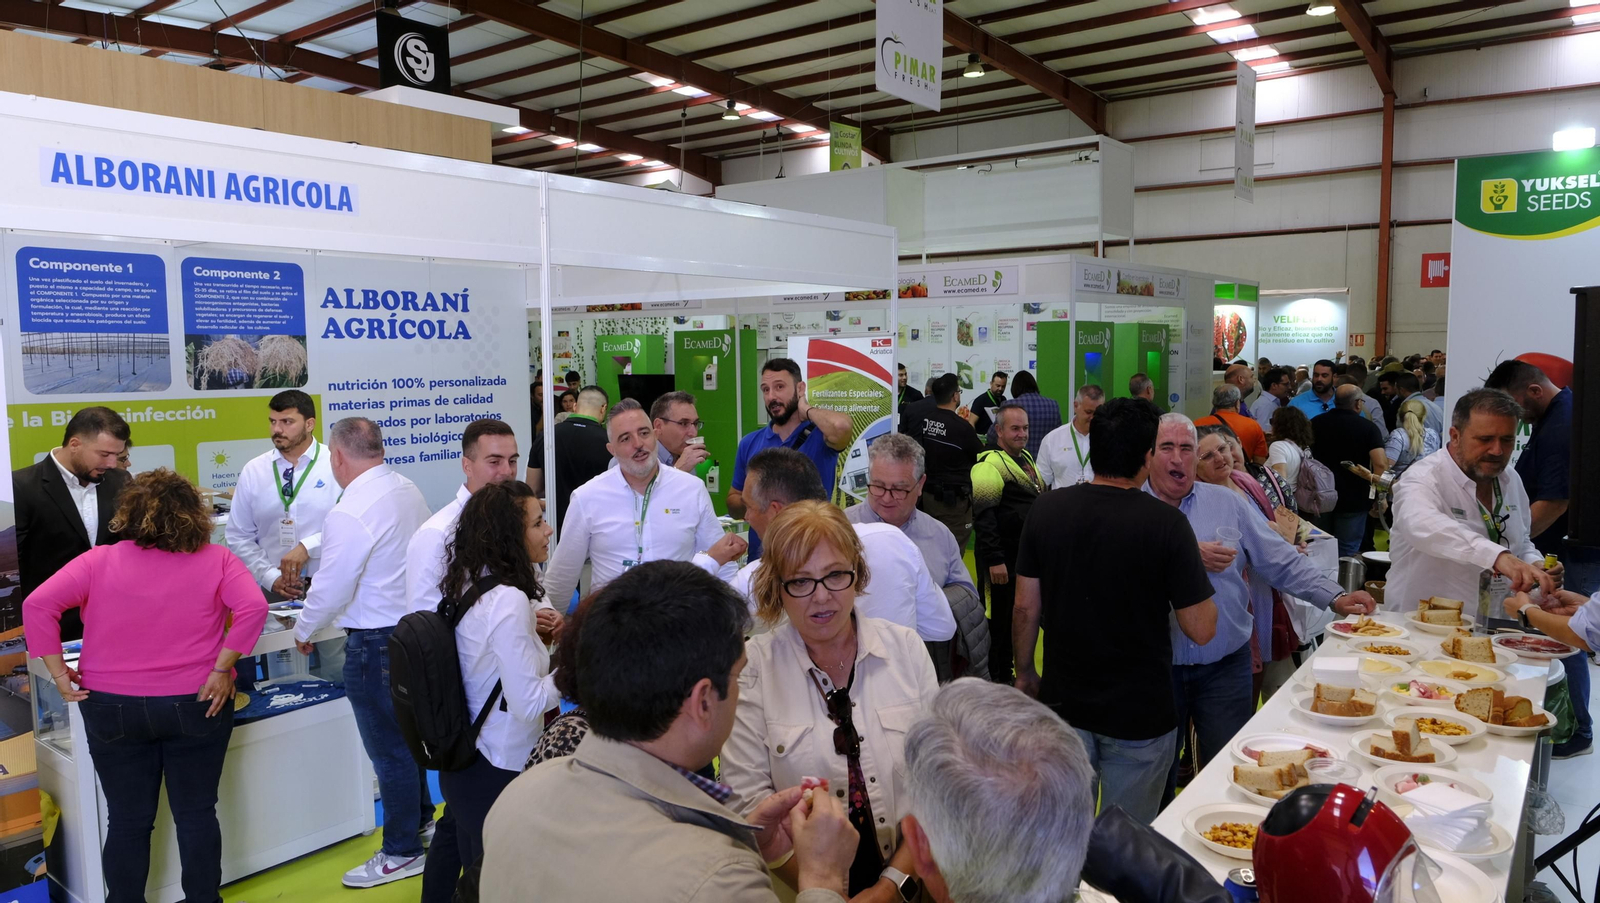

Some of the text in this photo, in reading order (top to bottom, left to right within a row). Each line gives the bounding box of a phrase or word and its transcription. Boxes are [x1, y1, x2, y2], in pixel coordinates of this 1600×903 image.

[894, 51, 935, 83] PIMAR
[894, 72, 928, 90] FRESH
[51, 152, 353, 212] ALBORANI AGRICOLA
[1521, 174, 1600, 192] YUKSEL
[1527, 192, 1591, 212] SEEDS
[29, 258, 133, 273] Componente 1
[193, 266, 280, 280] Componente 2
[320, 287, 470, 312] ALBORANÍ
[321, 313, 472, 340] AGRÍCOLA
[328, 375, 507, 391] nutrición 100% personalizada
[329, 393, 493, 411] materias primas de calidad
[22, 411, 42, 427] la
[411, 417, 430, 428] por
[435, 411, 501, 424] laboratorios
[929, 420, 944, 428] grupo
[410, 431, 463, 446] biológico
[928, 427, 946, 436] control
[419, 450, 462, 462] familiar
